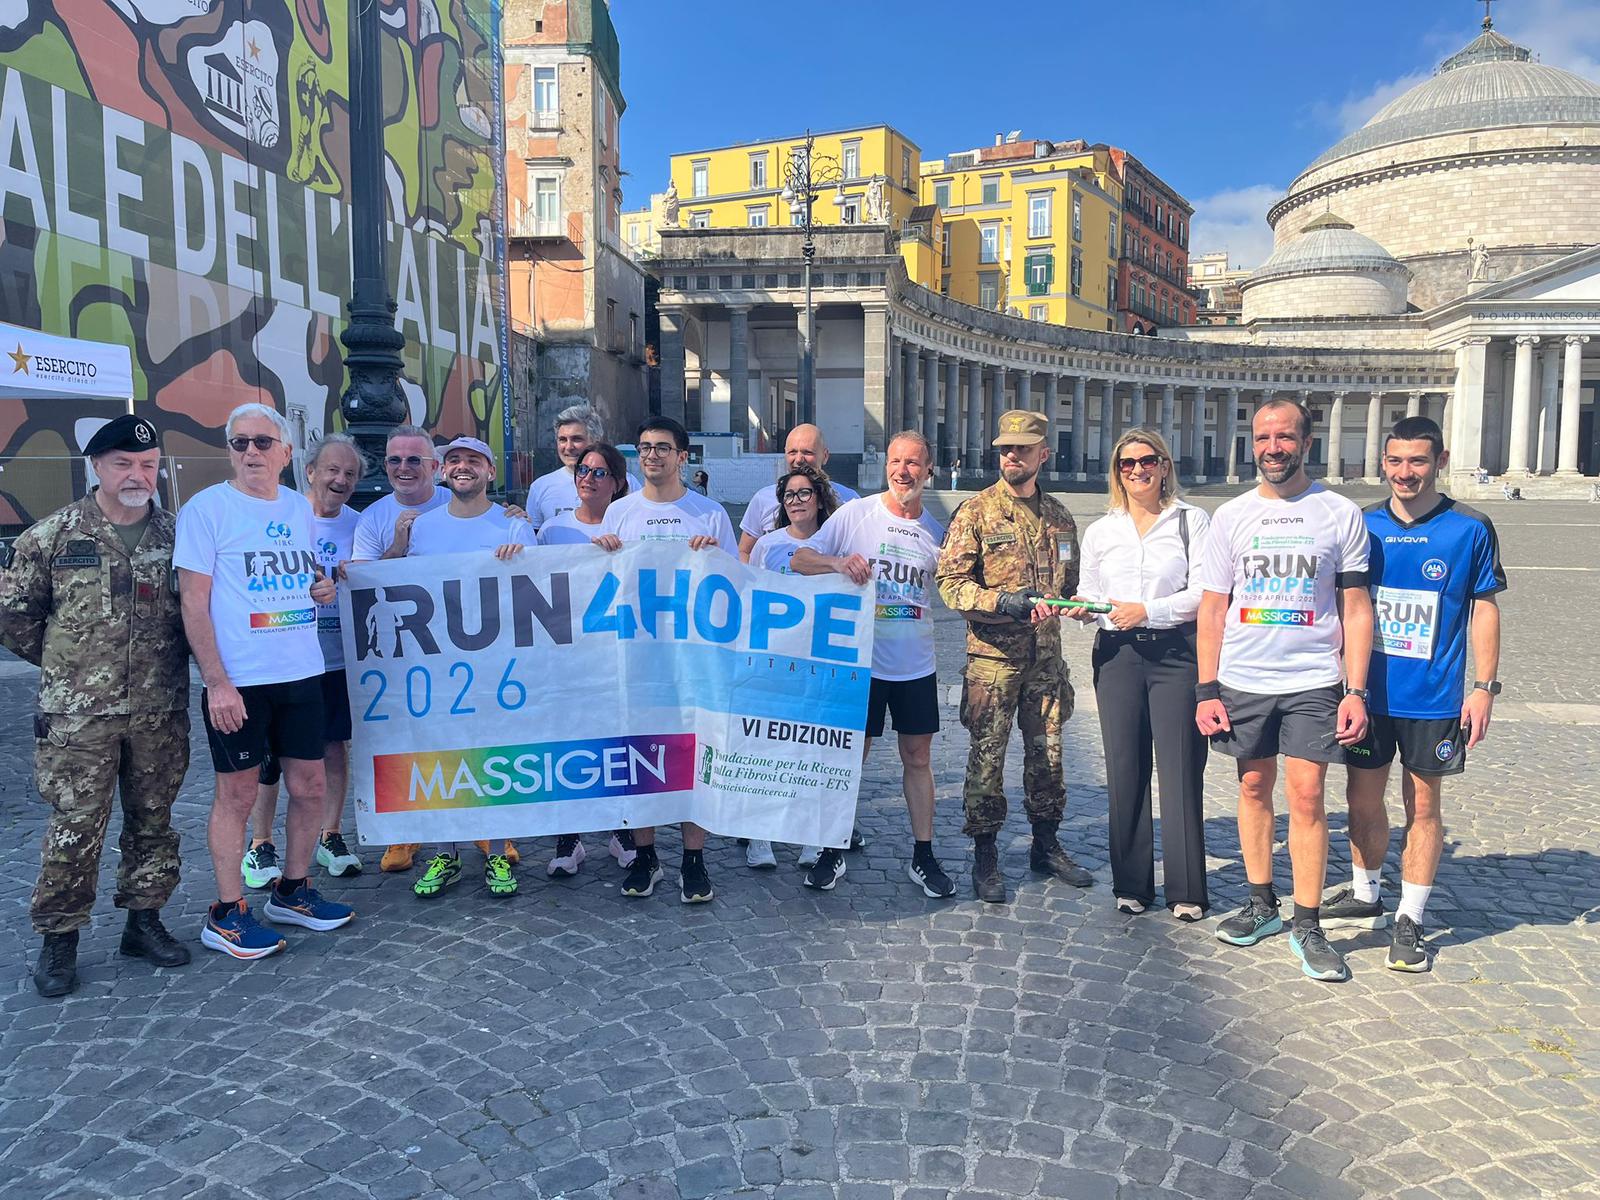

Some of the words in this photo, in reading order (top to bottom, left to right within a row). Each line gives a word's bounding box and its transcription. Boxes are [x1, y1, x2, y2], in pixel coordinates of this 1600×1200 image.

[235, 56, 274, 87] ESERCITO
[498, 252, 508, 366] INFRASTRUTTURE
[35, 356, 97, 377] ESERCITO
[502, 367, 510, 436] COMANDO
[888, 526, 920, 539] GIVOVA
[1262, 517, 1304, 525] GIVOVA
[1245, 611, 1309, 623] MASSIGEN
[747, 656, 858, 681] ITALIA
[360, 658, 527, 722] 2026
[742, 717, 761, 738] VI
[767, 721, 853, 750] EDIZIONE
[775, 759, 794, 771] per
[797, 760, 808, 771] la
[811, 762, 852, 777] Ricerca
[735, 769, 777, 783] Fibrosi
[779, 772, 817, 787] Cistica
[826, 778, 850, 791] ETS
